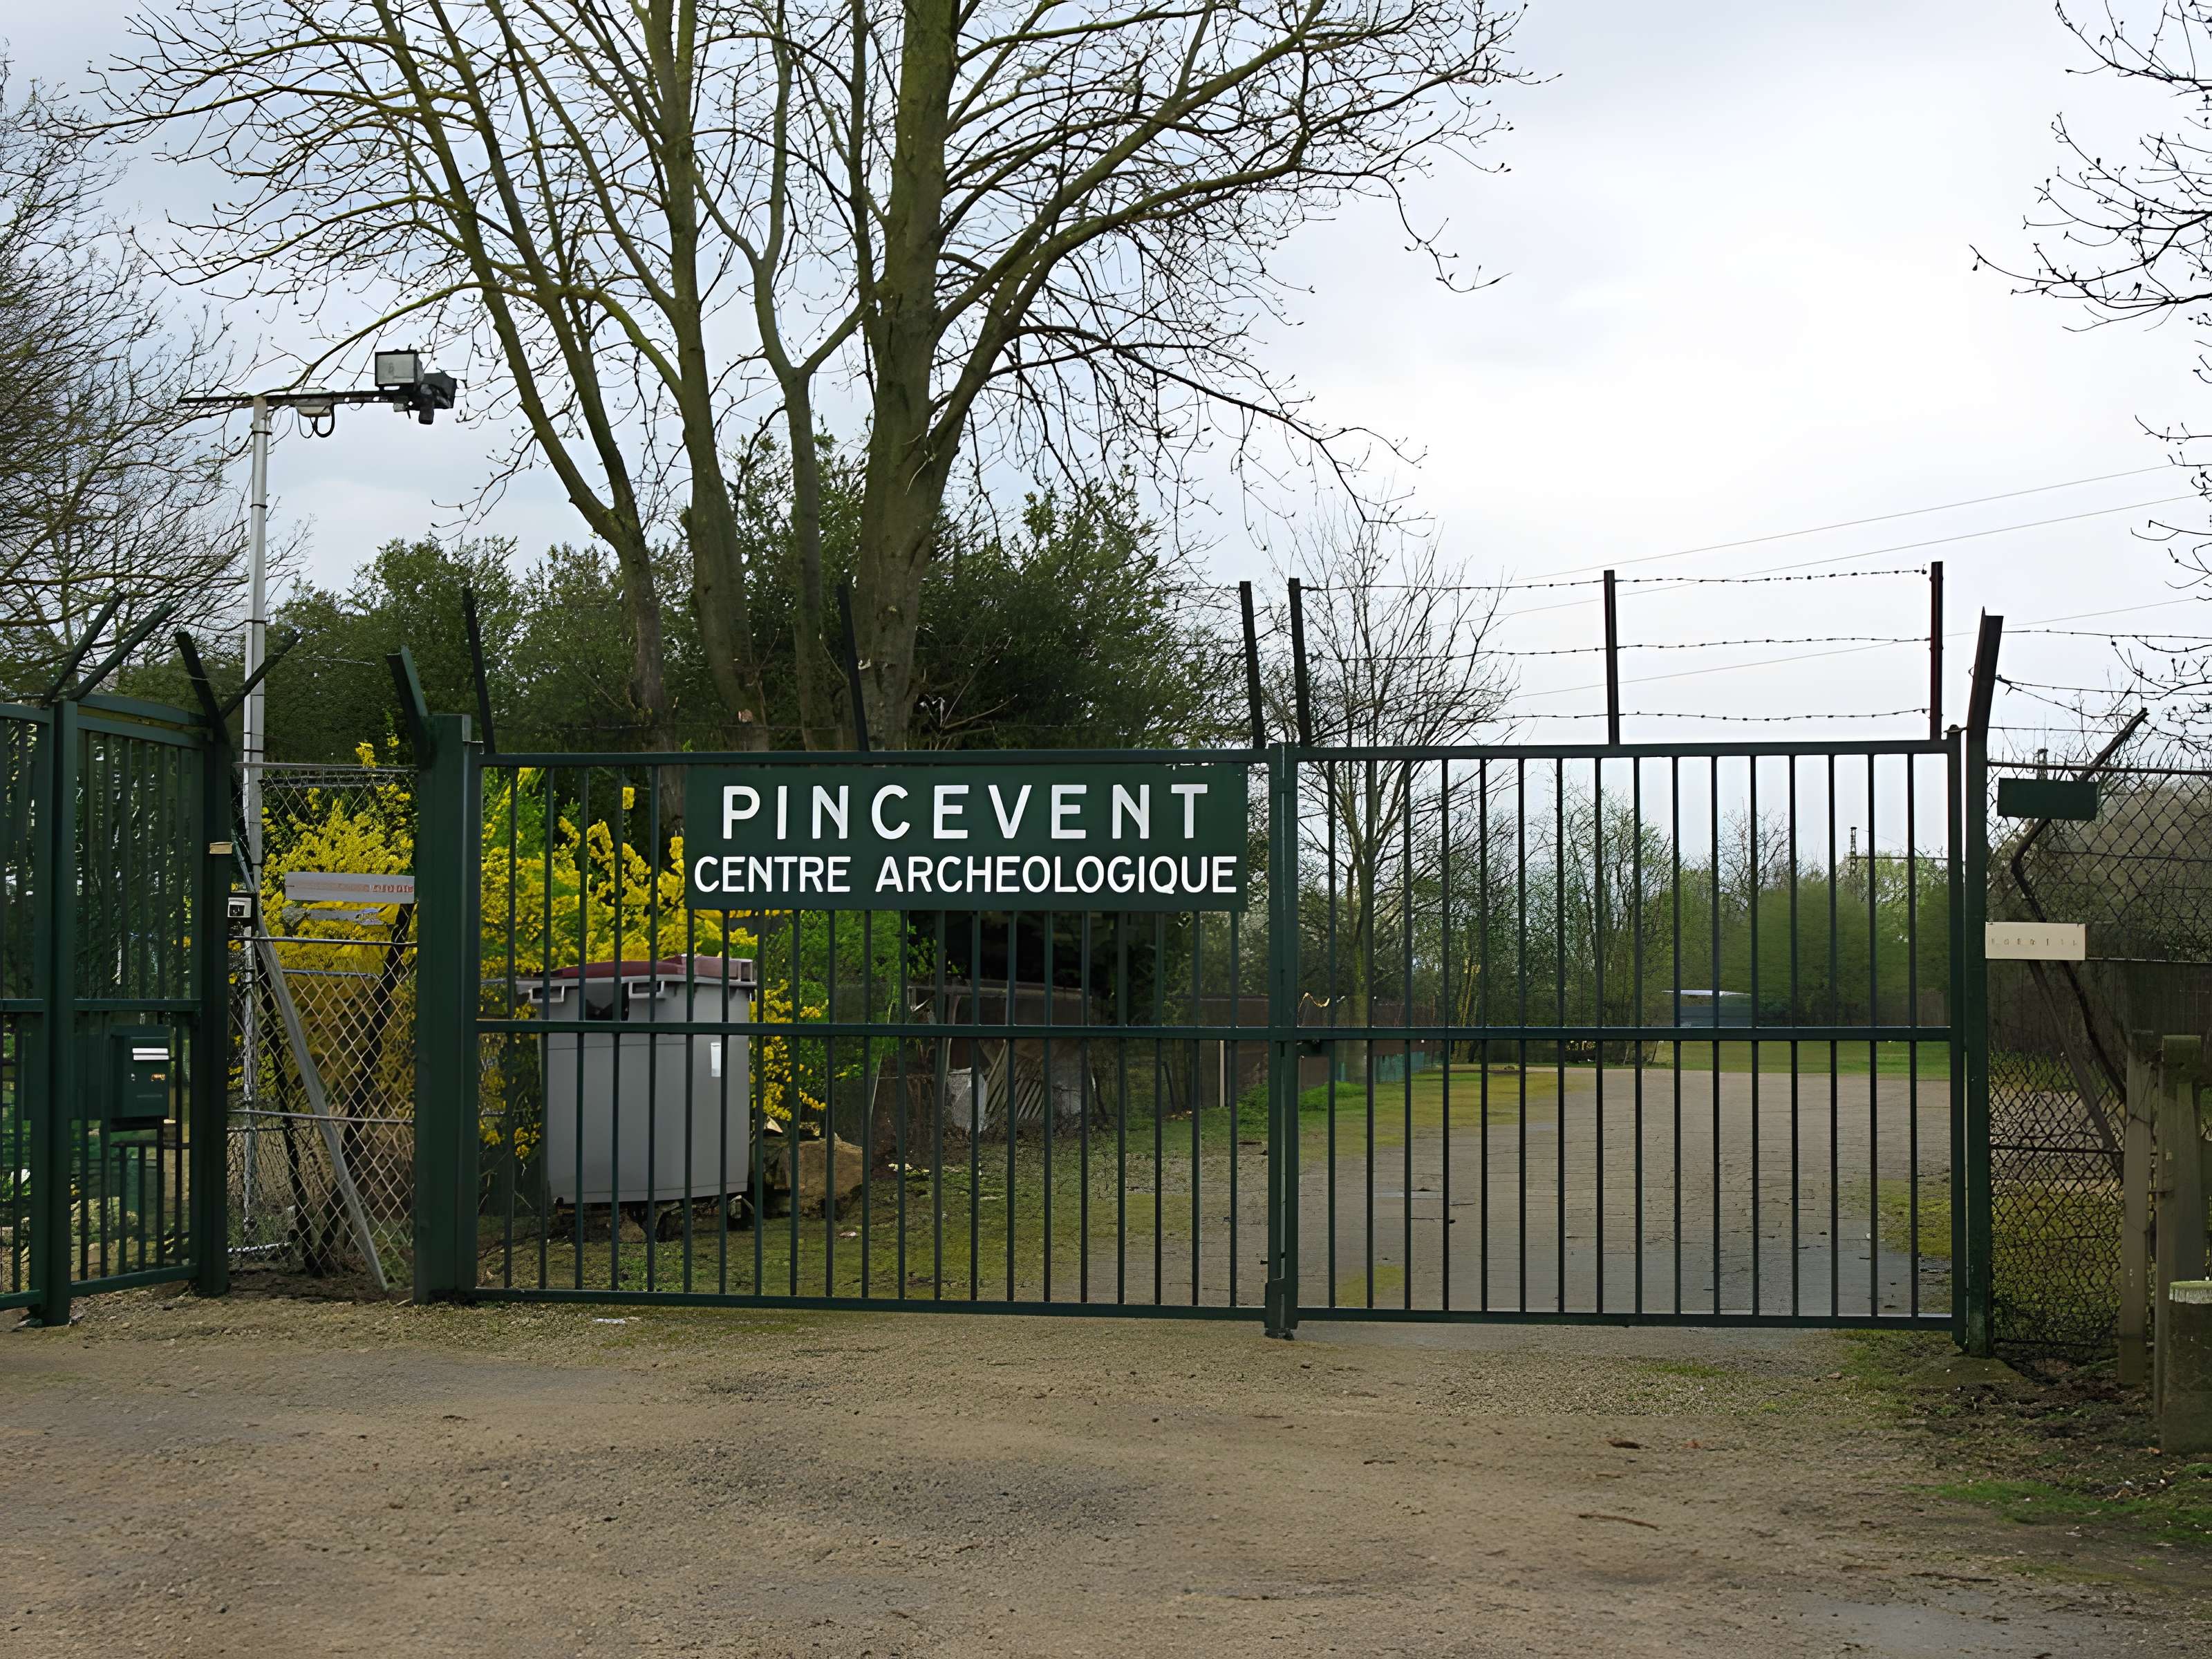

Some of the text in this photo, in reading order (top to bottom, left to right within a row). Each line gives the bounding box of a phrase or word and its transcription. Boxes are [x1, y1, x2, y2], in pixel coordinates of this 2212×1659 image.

[722, 784, 1208, 839] PINCEVENT
[694, 855, 1237, 895] CENTRE ARCHEOLOGIQUE
